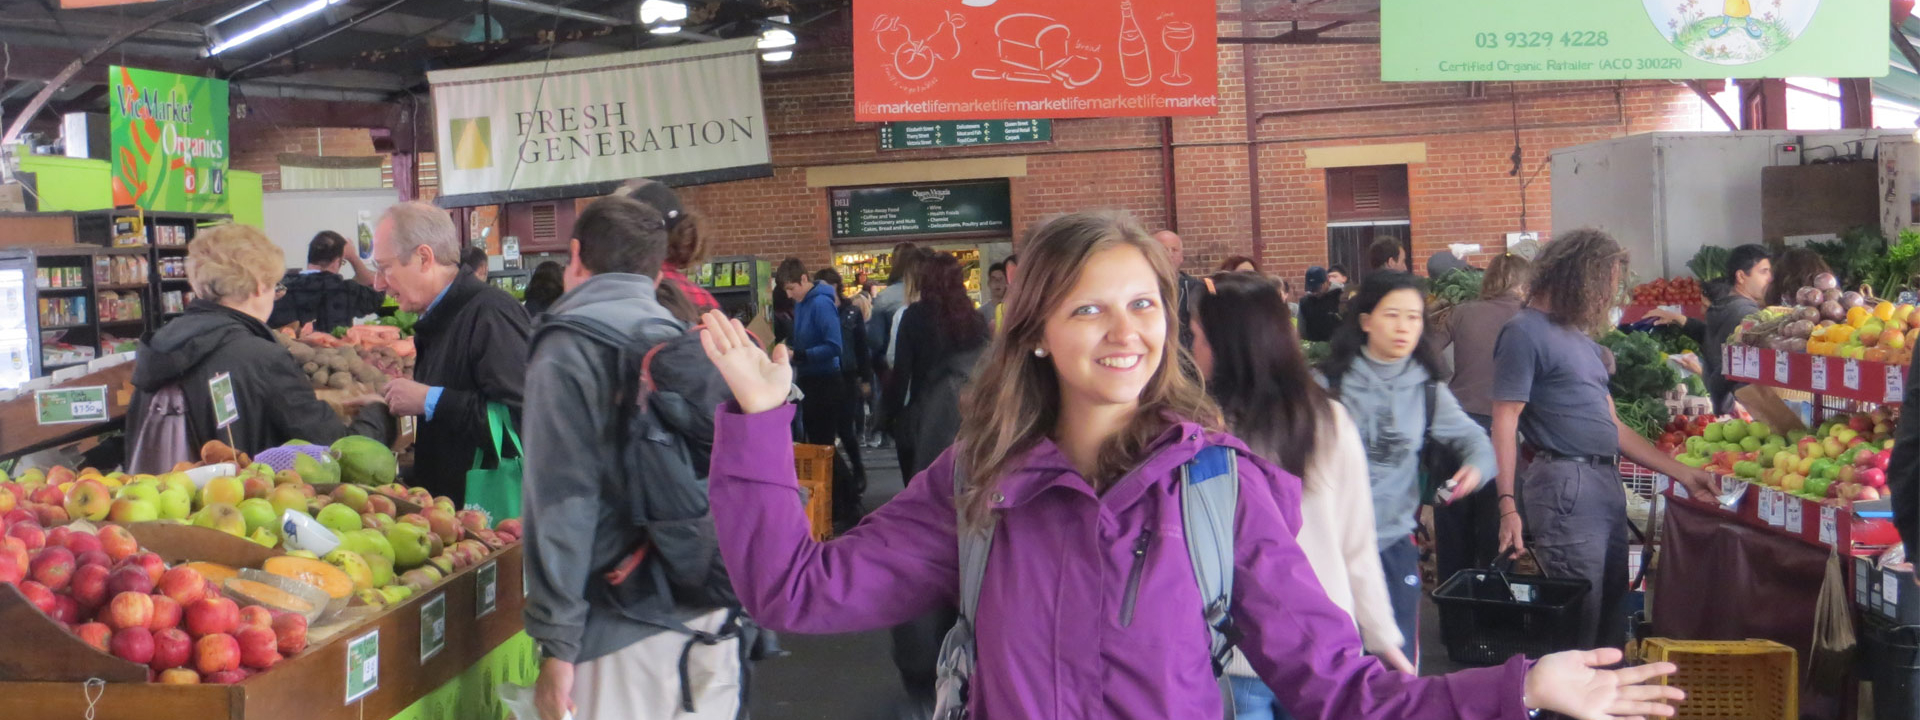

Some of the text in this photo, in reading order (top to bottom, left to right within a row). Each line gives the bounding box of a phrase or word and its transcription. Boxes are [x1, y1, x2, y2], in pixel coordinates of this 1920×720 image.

[1475, 31, 1609, 49] 03 9329 4228
[1438, 58, 1683, 73] Certified Organic Retailer (ACO 3002R)
[514, 102, 627, 136] FRESH
[162, 122, 223, 165] Organics
[519, 115, 754, 164] GENERATION
